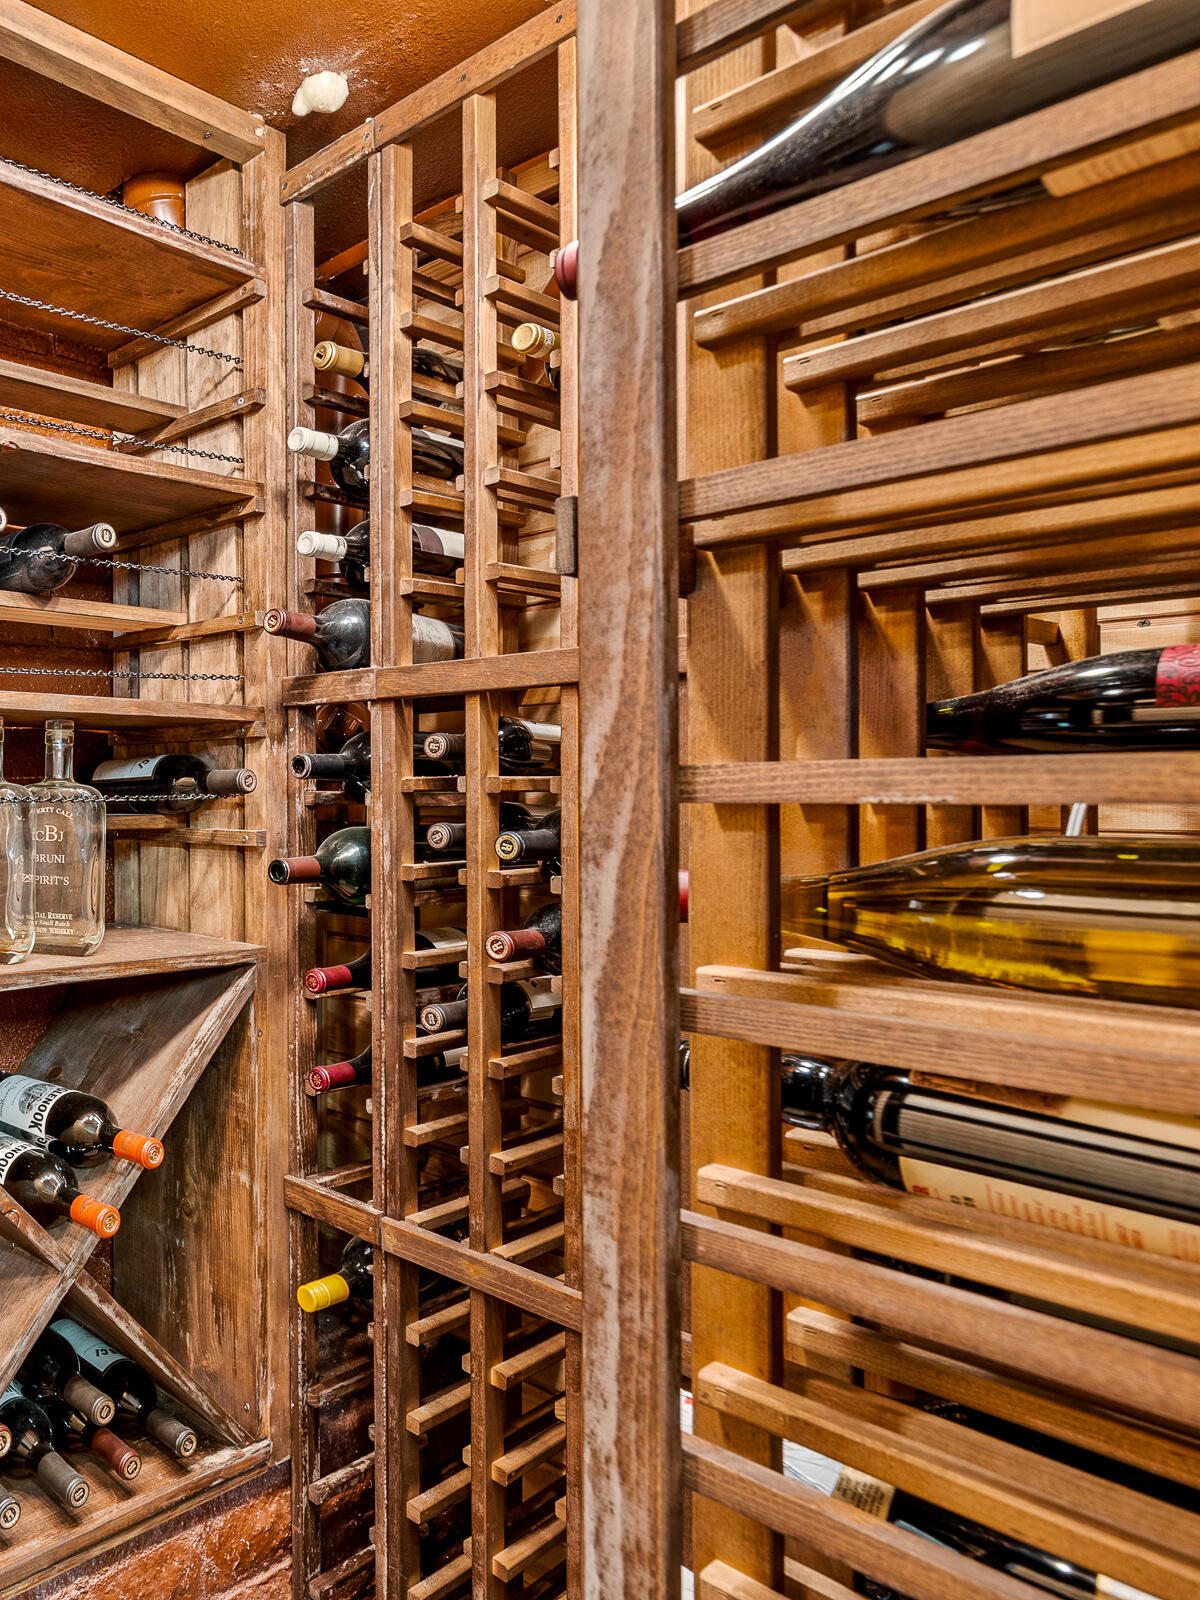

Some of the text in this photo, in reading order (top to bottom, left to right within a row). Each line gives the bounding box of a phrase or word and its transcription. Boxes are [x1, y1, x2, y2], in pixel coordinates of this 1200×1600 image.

[56, 807, 74, 820] CALL
[35, 876, 69, 886] PIRIT'S
[29, 1086, 69, 1134] GLENOOK
